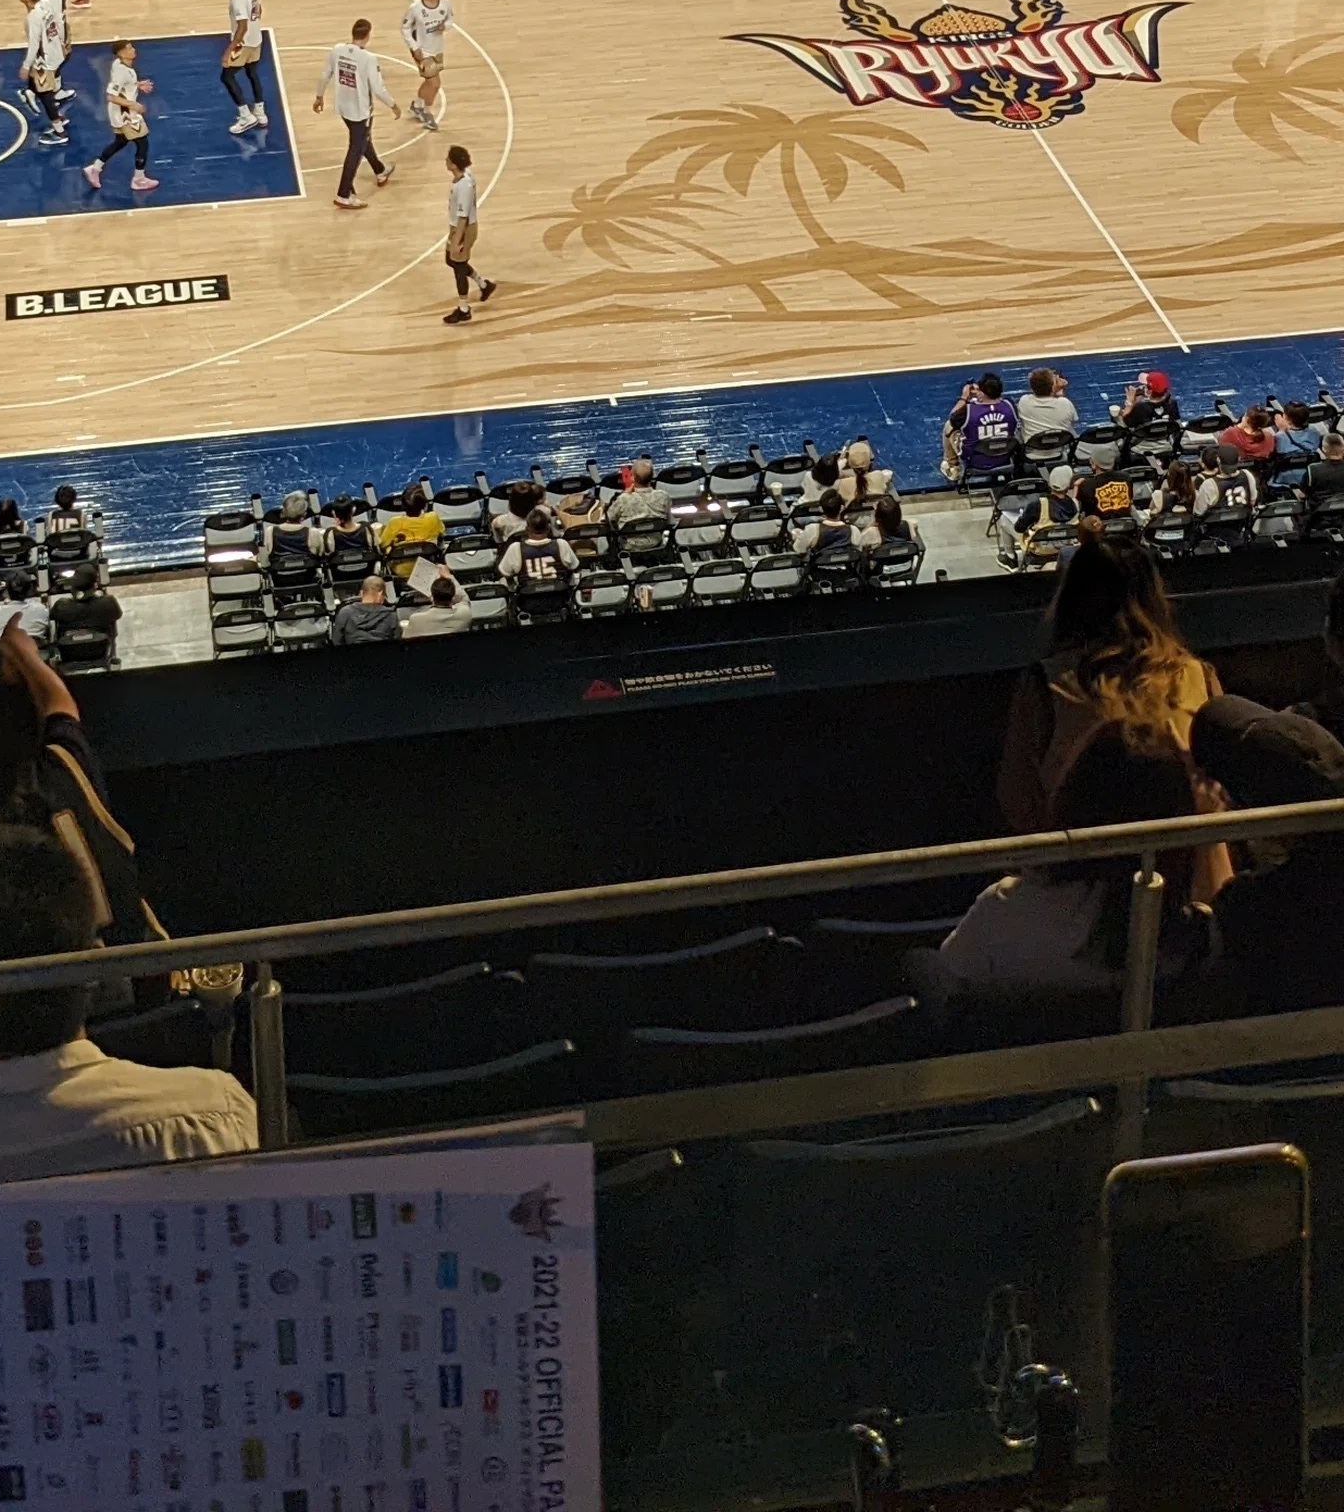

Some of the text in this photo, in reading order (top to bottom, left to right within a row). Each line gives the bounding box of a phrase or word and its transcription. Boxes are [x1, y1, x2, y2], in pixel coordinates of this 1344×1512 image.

[927, 30, 1014, 44] KINGS
[15, 278, 220, 317] B.LEAGUE
[977, 422, 1009, 441] 45
[524, 554, 558, 580] 45
[531, 1254, 561, 1350] 2021-22
[534, 1356, 565, 1474] OFFICIAL
